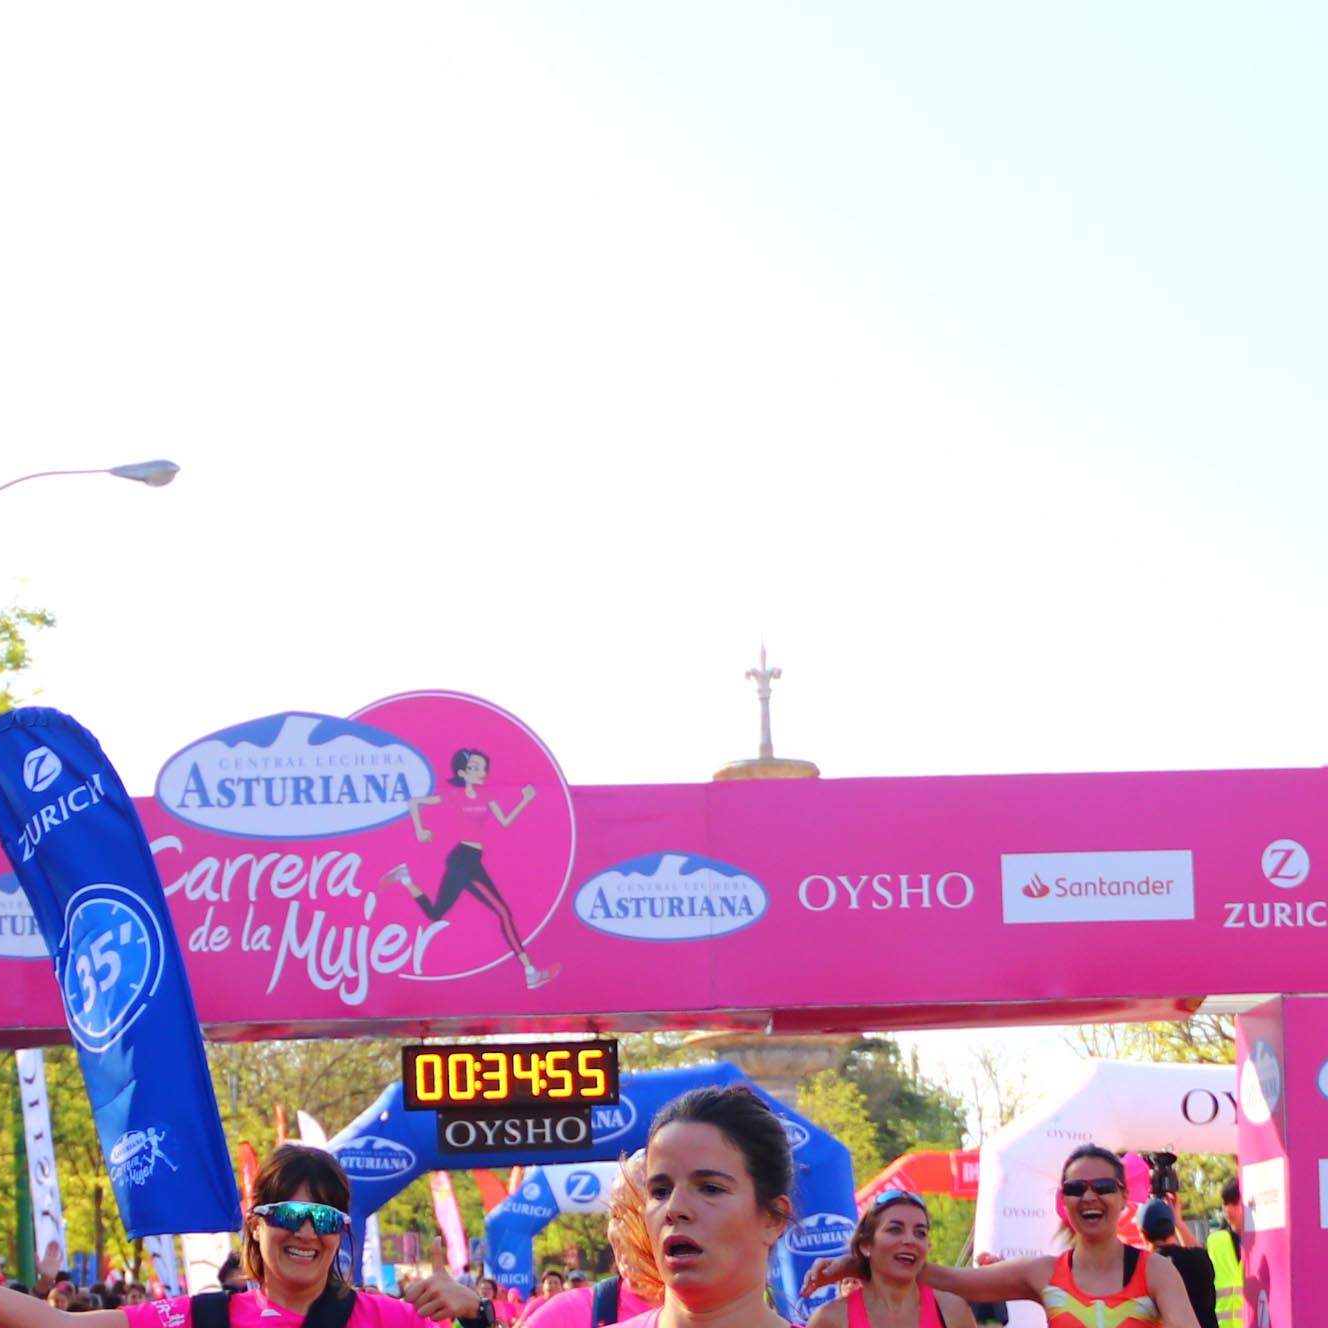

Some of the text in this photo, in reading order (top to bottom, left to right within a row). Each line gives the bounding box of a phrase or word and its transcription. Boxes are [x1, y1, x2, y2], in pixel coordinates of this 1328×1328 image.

[219, 752, 404, 769] CENTRAL LECHERA
[177, 761, 413, 808] ASTURIANA
[17, 773, 106, 862] ZURICH
[149, 835, 364, 901] Carrera
[589, 886, 755, 919] ASTURIANA
[798, 872, 975, 912] OYSHO
[1054, 875, 1175, 899] Santander
[189, 893, 449, 1006] de la Mujer
[76, 921, 132, 1013] 35'
[415, 1050, 607, 1101] 00:34:55
[445, 1116, 587, 1148] OYSHO
[338, 1154, 409, 1171] STURIANA
[503, 1203, 553, 1217] ZURICH
[789, 1228, 853, 1249] ASTURIAN
[494, 1272, 529, 1285] URICH
